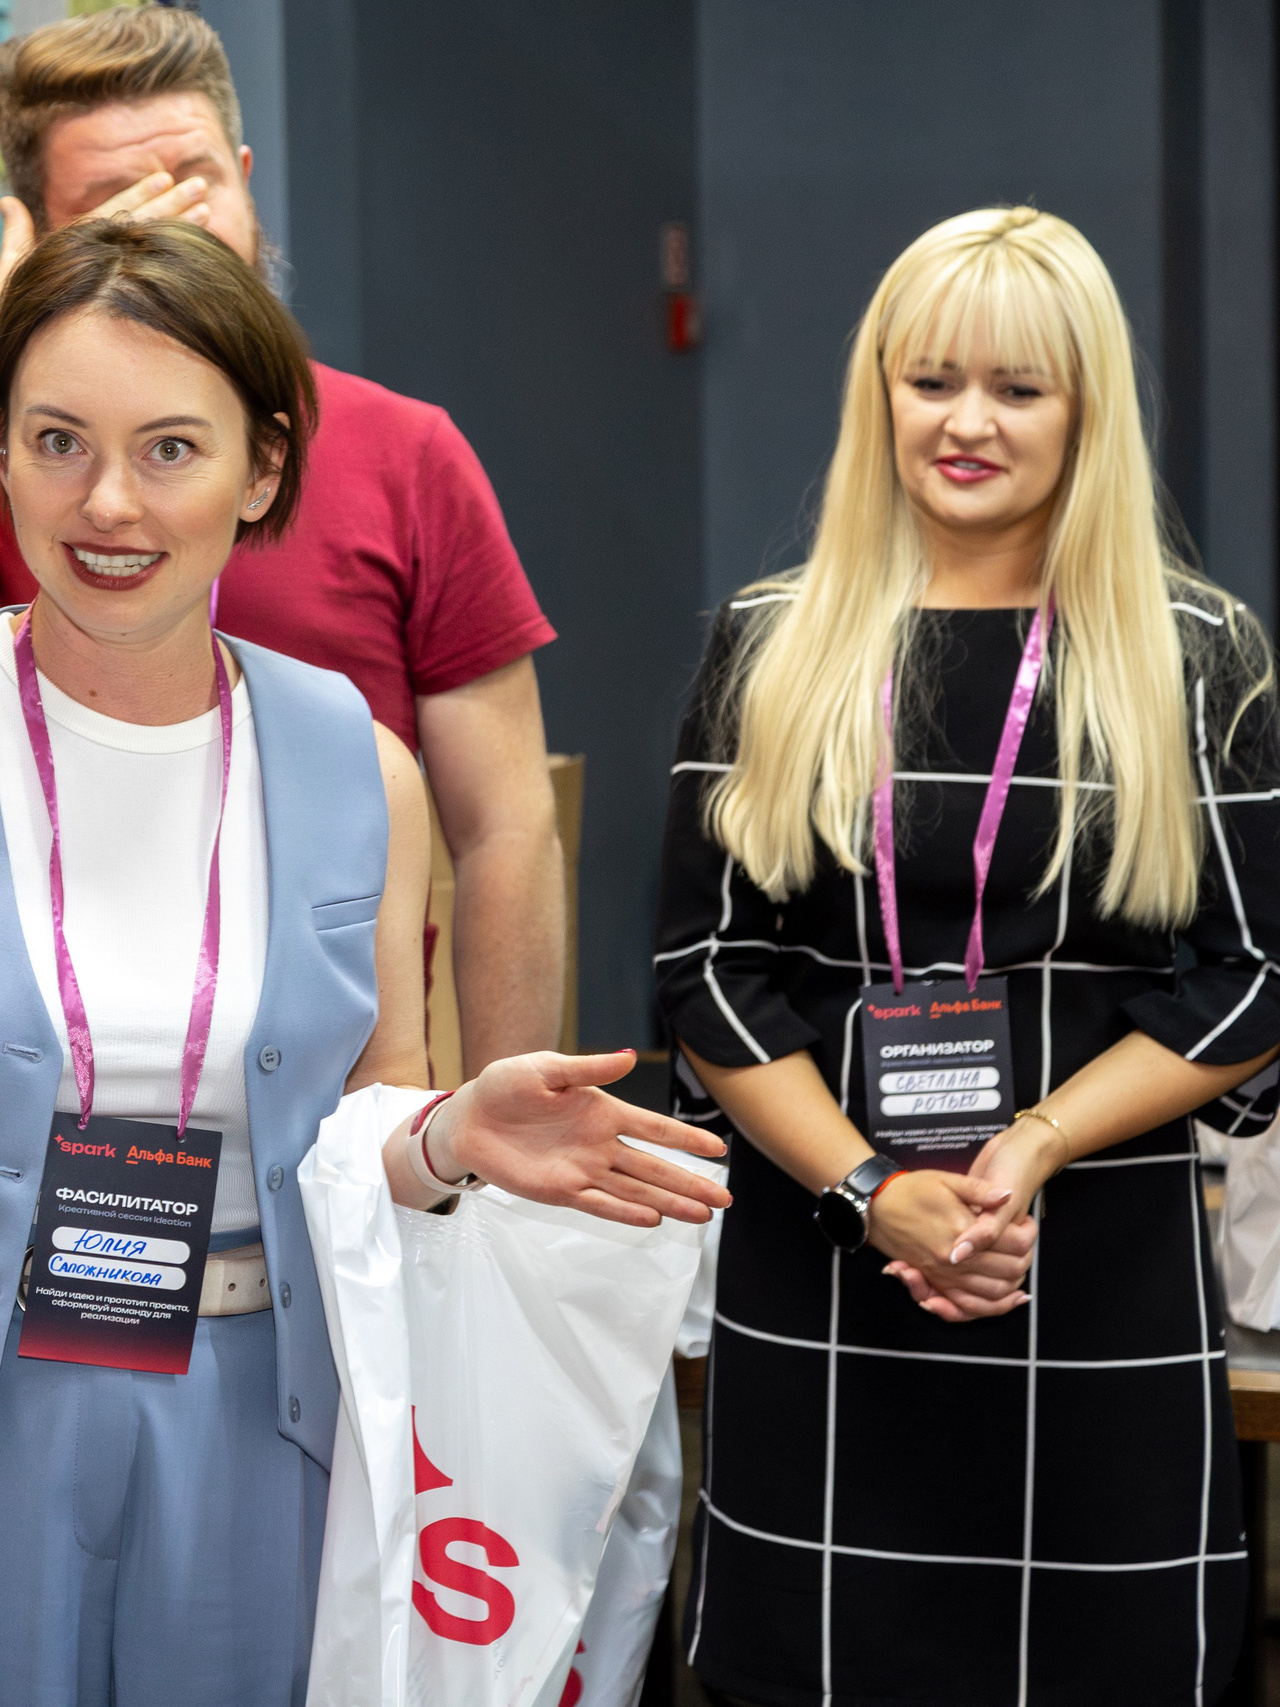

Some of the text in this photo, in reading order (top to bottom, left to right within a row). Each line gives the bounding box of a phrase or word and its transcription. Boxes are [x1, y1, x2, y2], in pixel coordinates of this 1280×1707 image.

[873, 1004, 921, 1020] spark
[880, 1039, 995, 1059] ОРГАНИЗАТОР
[895, 1070, 980, 1091] СВЕТЛАНА
[60, 1141, 116, 1158] spark
[126, 1145, 212, 1168] Альфа Банк
[55, 1187, 199, 1216] ФАСИЛИТАТОР
[58, 1204, 192, 1228] Креативной сессии Ideation
[36, 1286, 68, 1299] Найди
[68, 1291, 95, 1302] идею
[103, 1296, 149, 1309] прототип
[149, 1302, 190, 1313] проекта,
[51, 1298, 172, 1320] сформируй команду для
[80, 1311, 140, 1326] реализации
